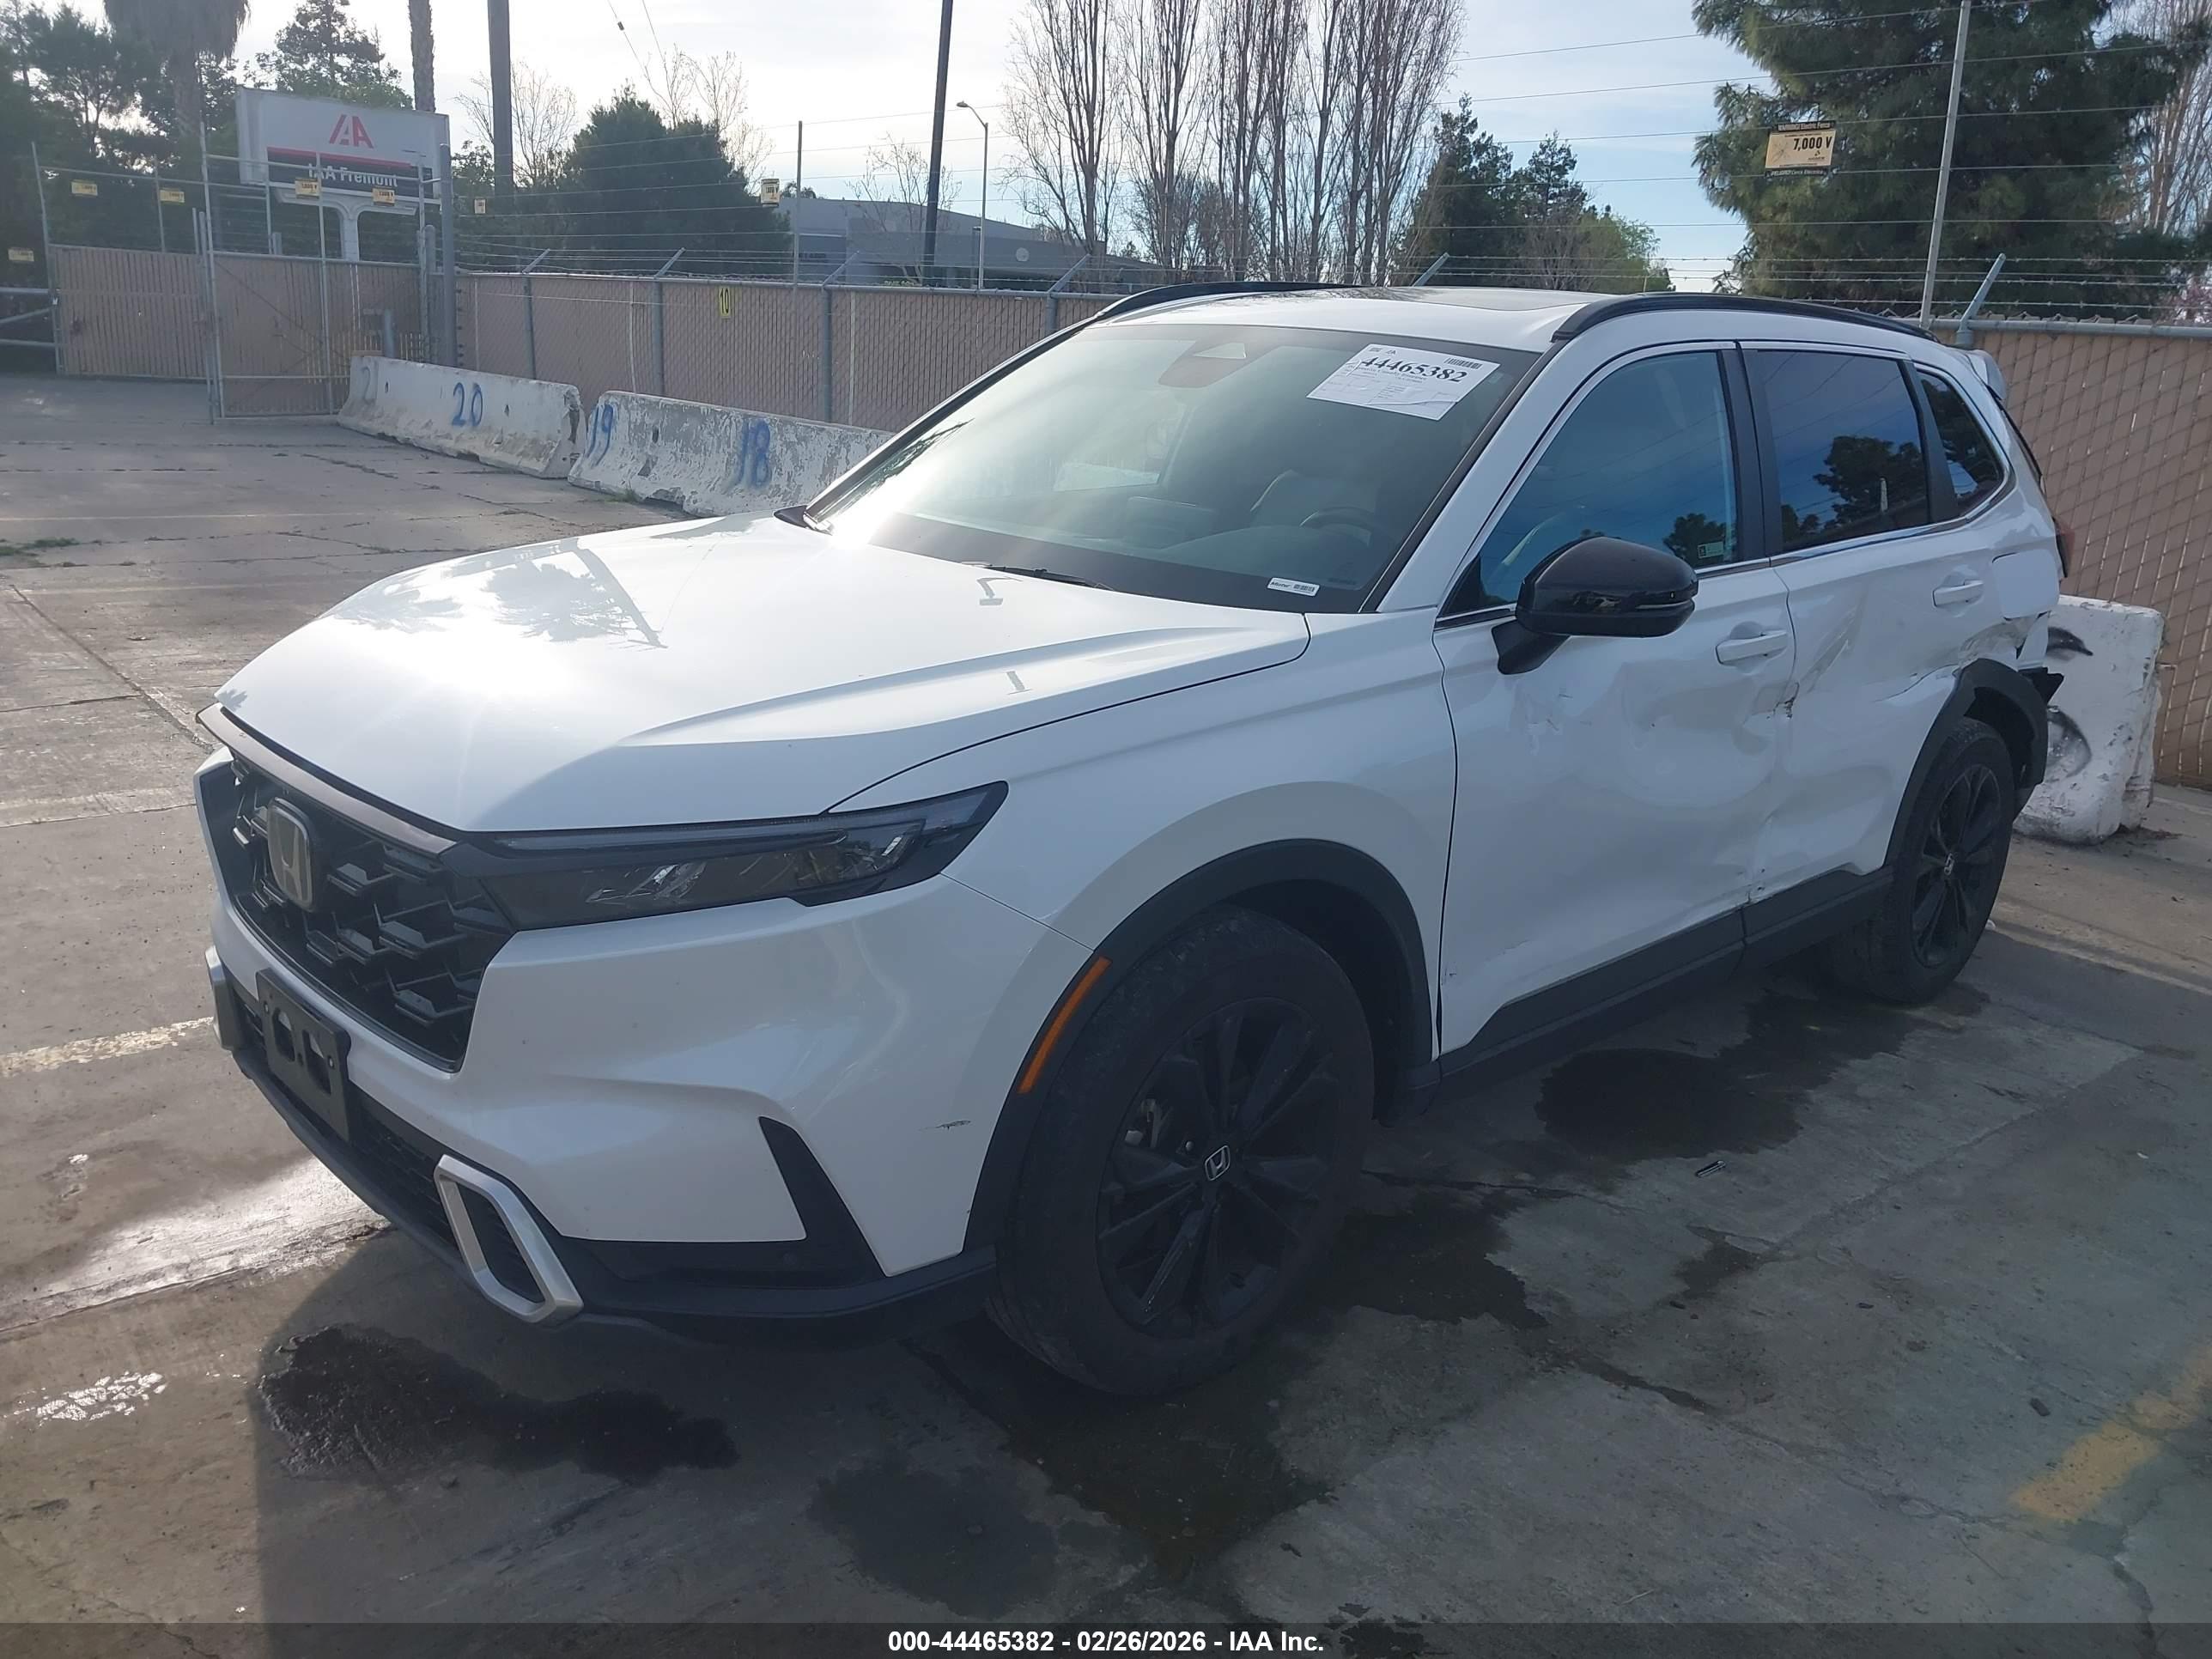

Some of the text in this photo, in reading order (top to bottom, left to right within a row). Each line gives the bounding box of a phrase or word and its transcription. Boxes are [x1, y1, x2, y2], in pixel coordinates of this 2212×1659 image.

[1793, 137, 1833, 151] 7,000 V
[340, 167, 398, 187] Fremont
[720, 287, 729, 314] 10
[1361, 356, 1468, 383] 44465382
[453, 382, 483, 427] 20
[586, 404, 614, 466] 19
[735, 418, 771, 488] 18
